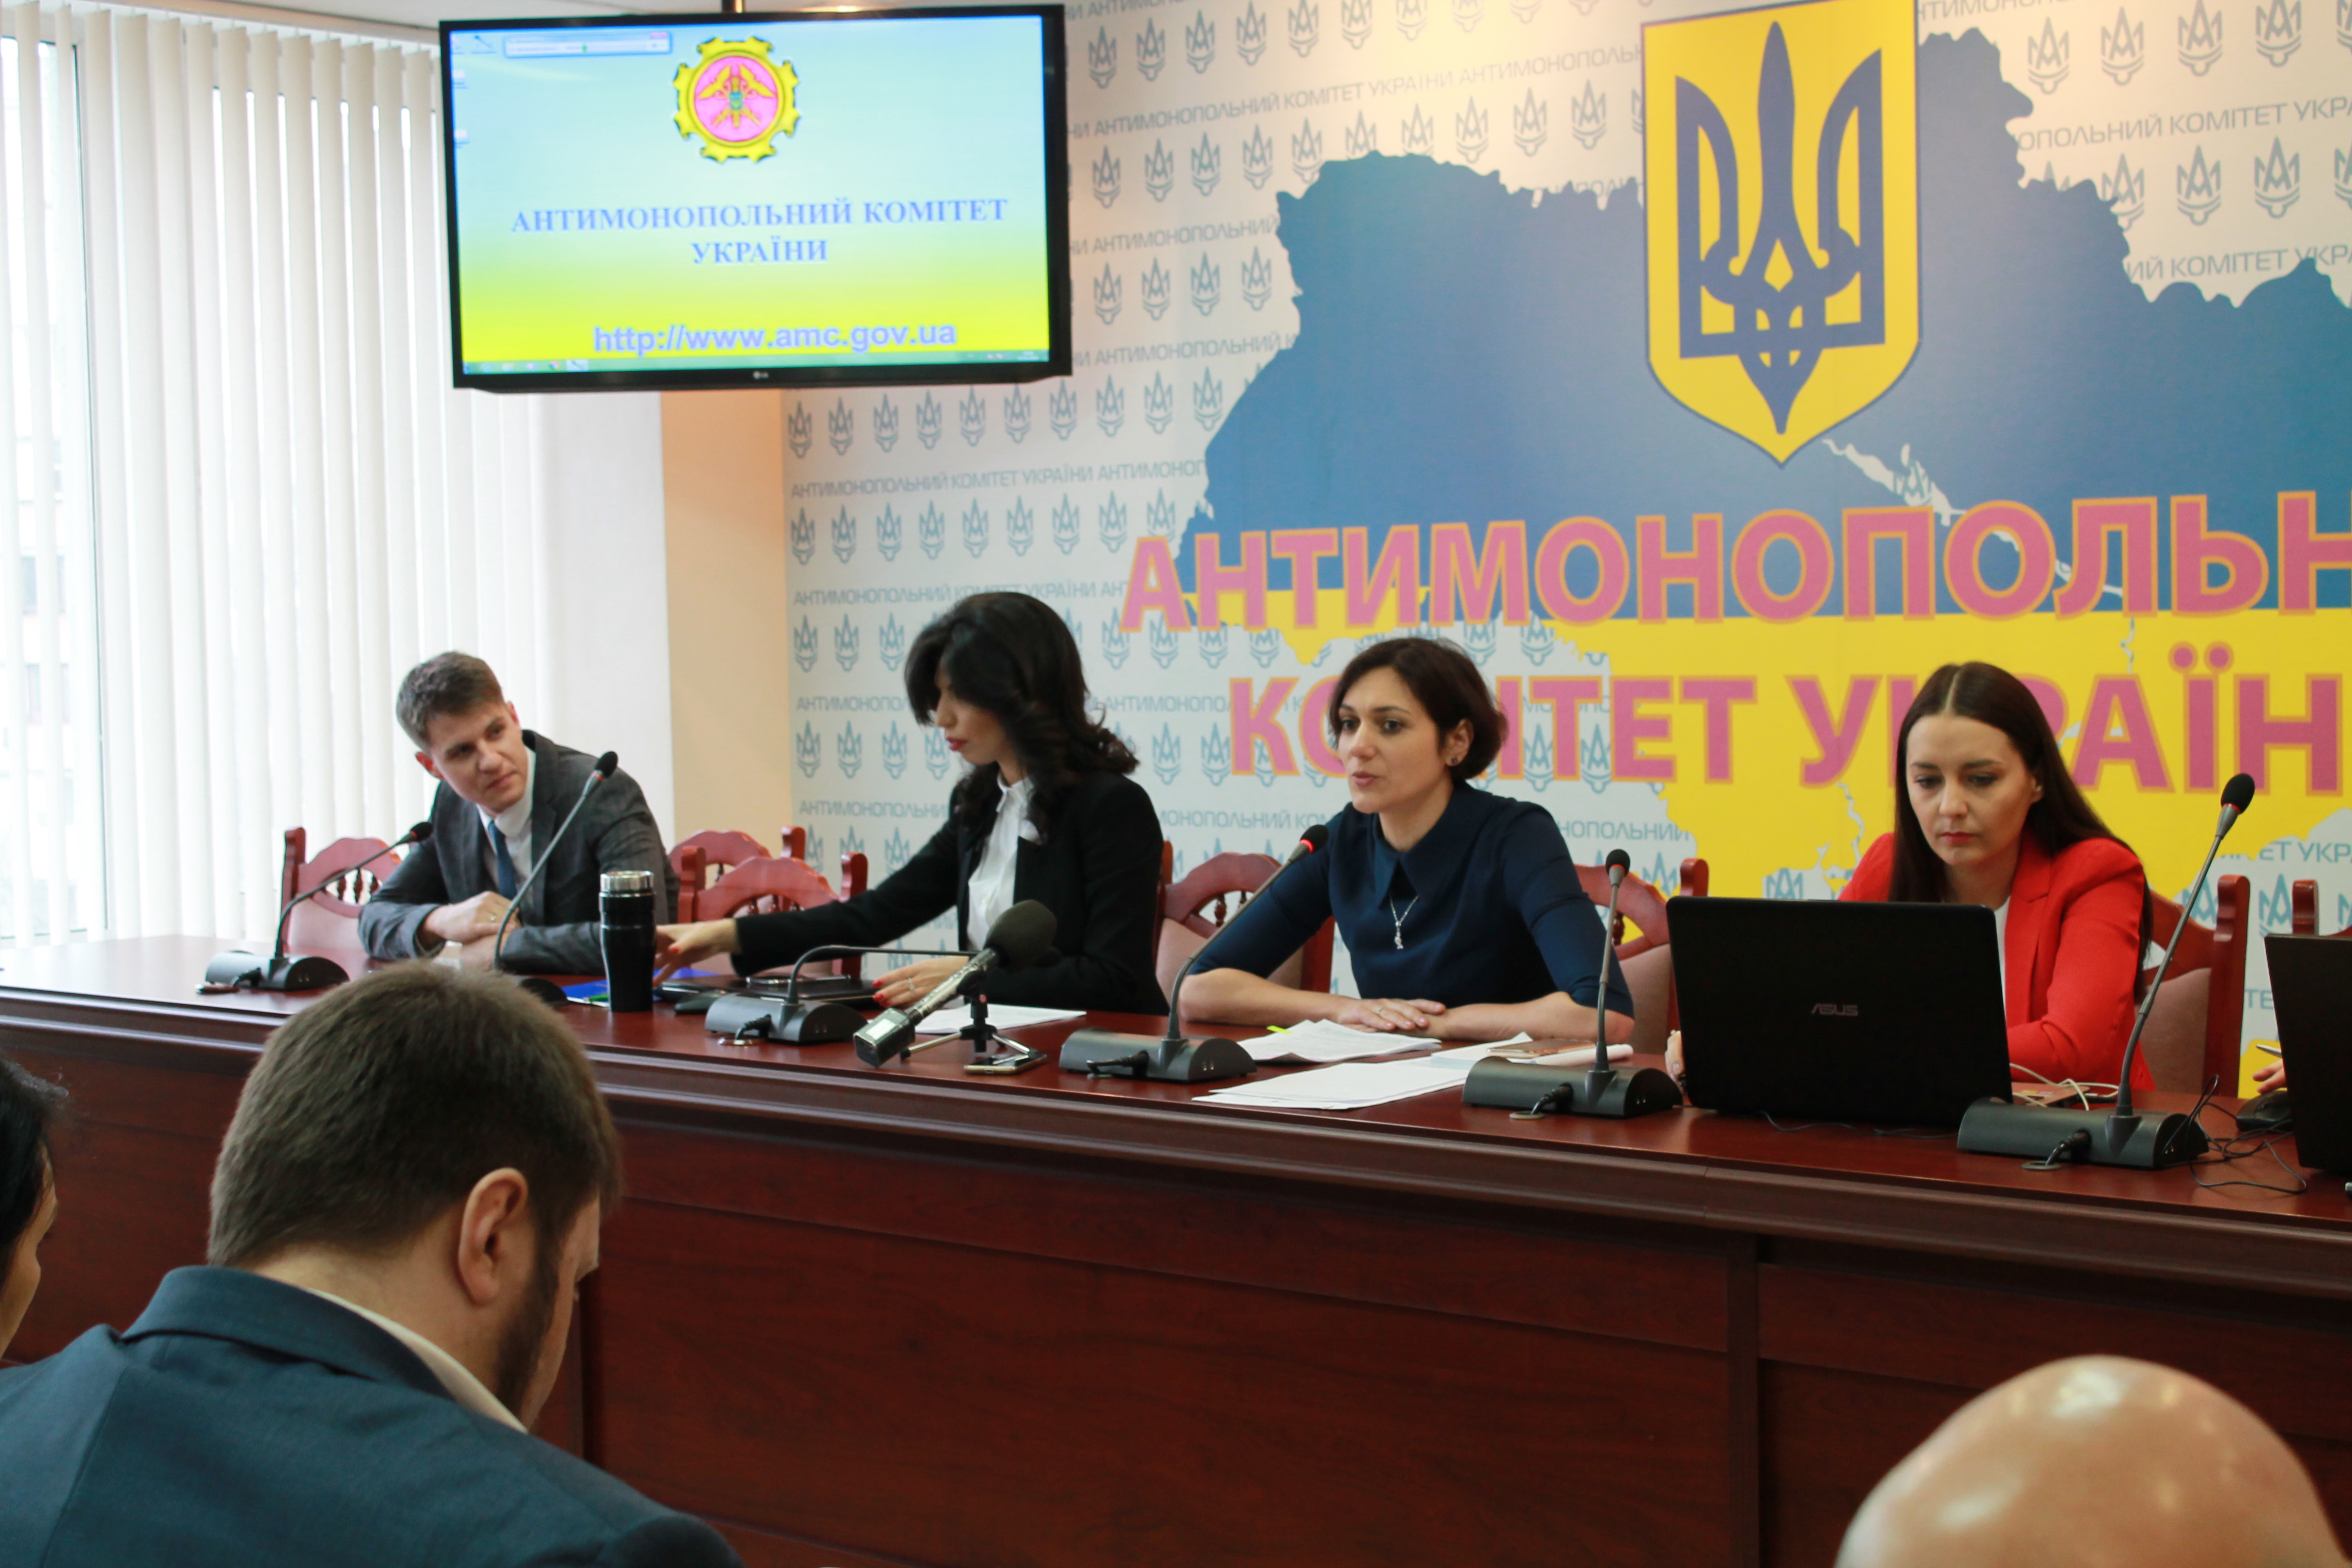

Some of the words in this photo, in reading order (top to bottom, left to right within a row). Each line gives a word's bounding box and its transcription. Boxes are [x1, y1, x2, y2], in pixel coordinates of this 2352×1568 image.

[1093, 91, 1281, 137] АНТИМОНОПОЛЬНИЙ
[1283, 83, 1364, 109] КОМІТЕТ
[1368, 70, 1453, 97] УКРАЇНИ
[2013, 115, 2163, 151] ОПОЛЬНИЙ
[2169, 102, 2289, 135] КОМІТЕТ
[511, 198, 852, 233] АНТИМОНОПОЛЬНИЙ
[863, 198, 1009, 224] КОМІТЕТ
[690, 239, 828, 264] УКРАЇНИ
[1093, 215, 1281, 253] АНТИМОНОПОЛЬНИЙ
[2171, 248, 2289, 278] КОМІТЕТ
[593, 322, 956, 355] http://www.amc.gov.ua
[1095, 331, 1281, 366] АНТИМОНОПОЛЬНИЙ
[791, 471, 949, 499] АНТИМОНОПОЛЬНИЙ
[951, 470, 1017, 489] КОМІТЕТ
[1022, 463, 1093, 484] УКРАЇНИ
[796, 695, 911, 712] АНТИМОНОПО
[1228, 673, 1758, 785] КІТЕТ
[1784, 641, 2345, 796] УАЇН
[1811, 1003, 1859, 1016] ASUS
